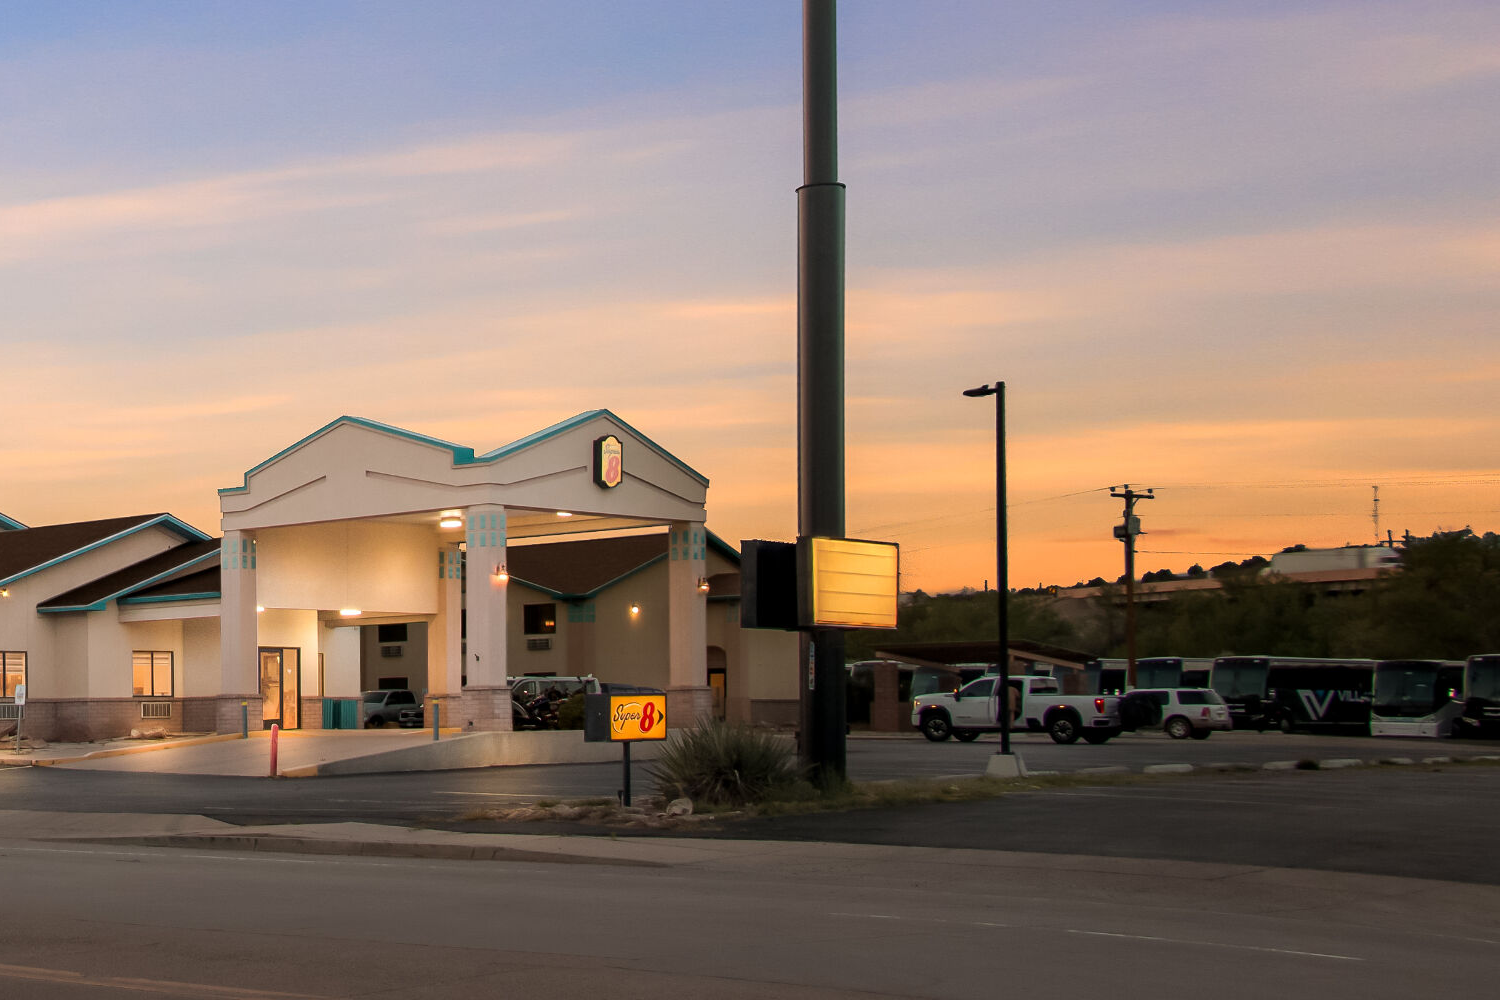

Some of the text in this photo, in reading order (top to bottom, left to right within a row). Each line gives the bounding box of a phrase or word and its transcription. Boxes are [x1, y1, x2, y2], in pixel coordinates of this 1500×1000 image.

[604, 444, 620, 457] Super
[606, 456, 620, 483] 8
[613, 702, 655, 733] Super 8
